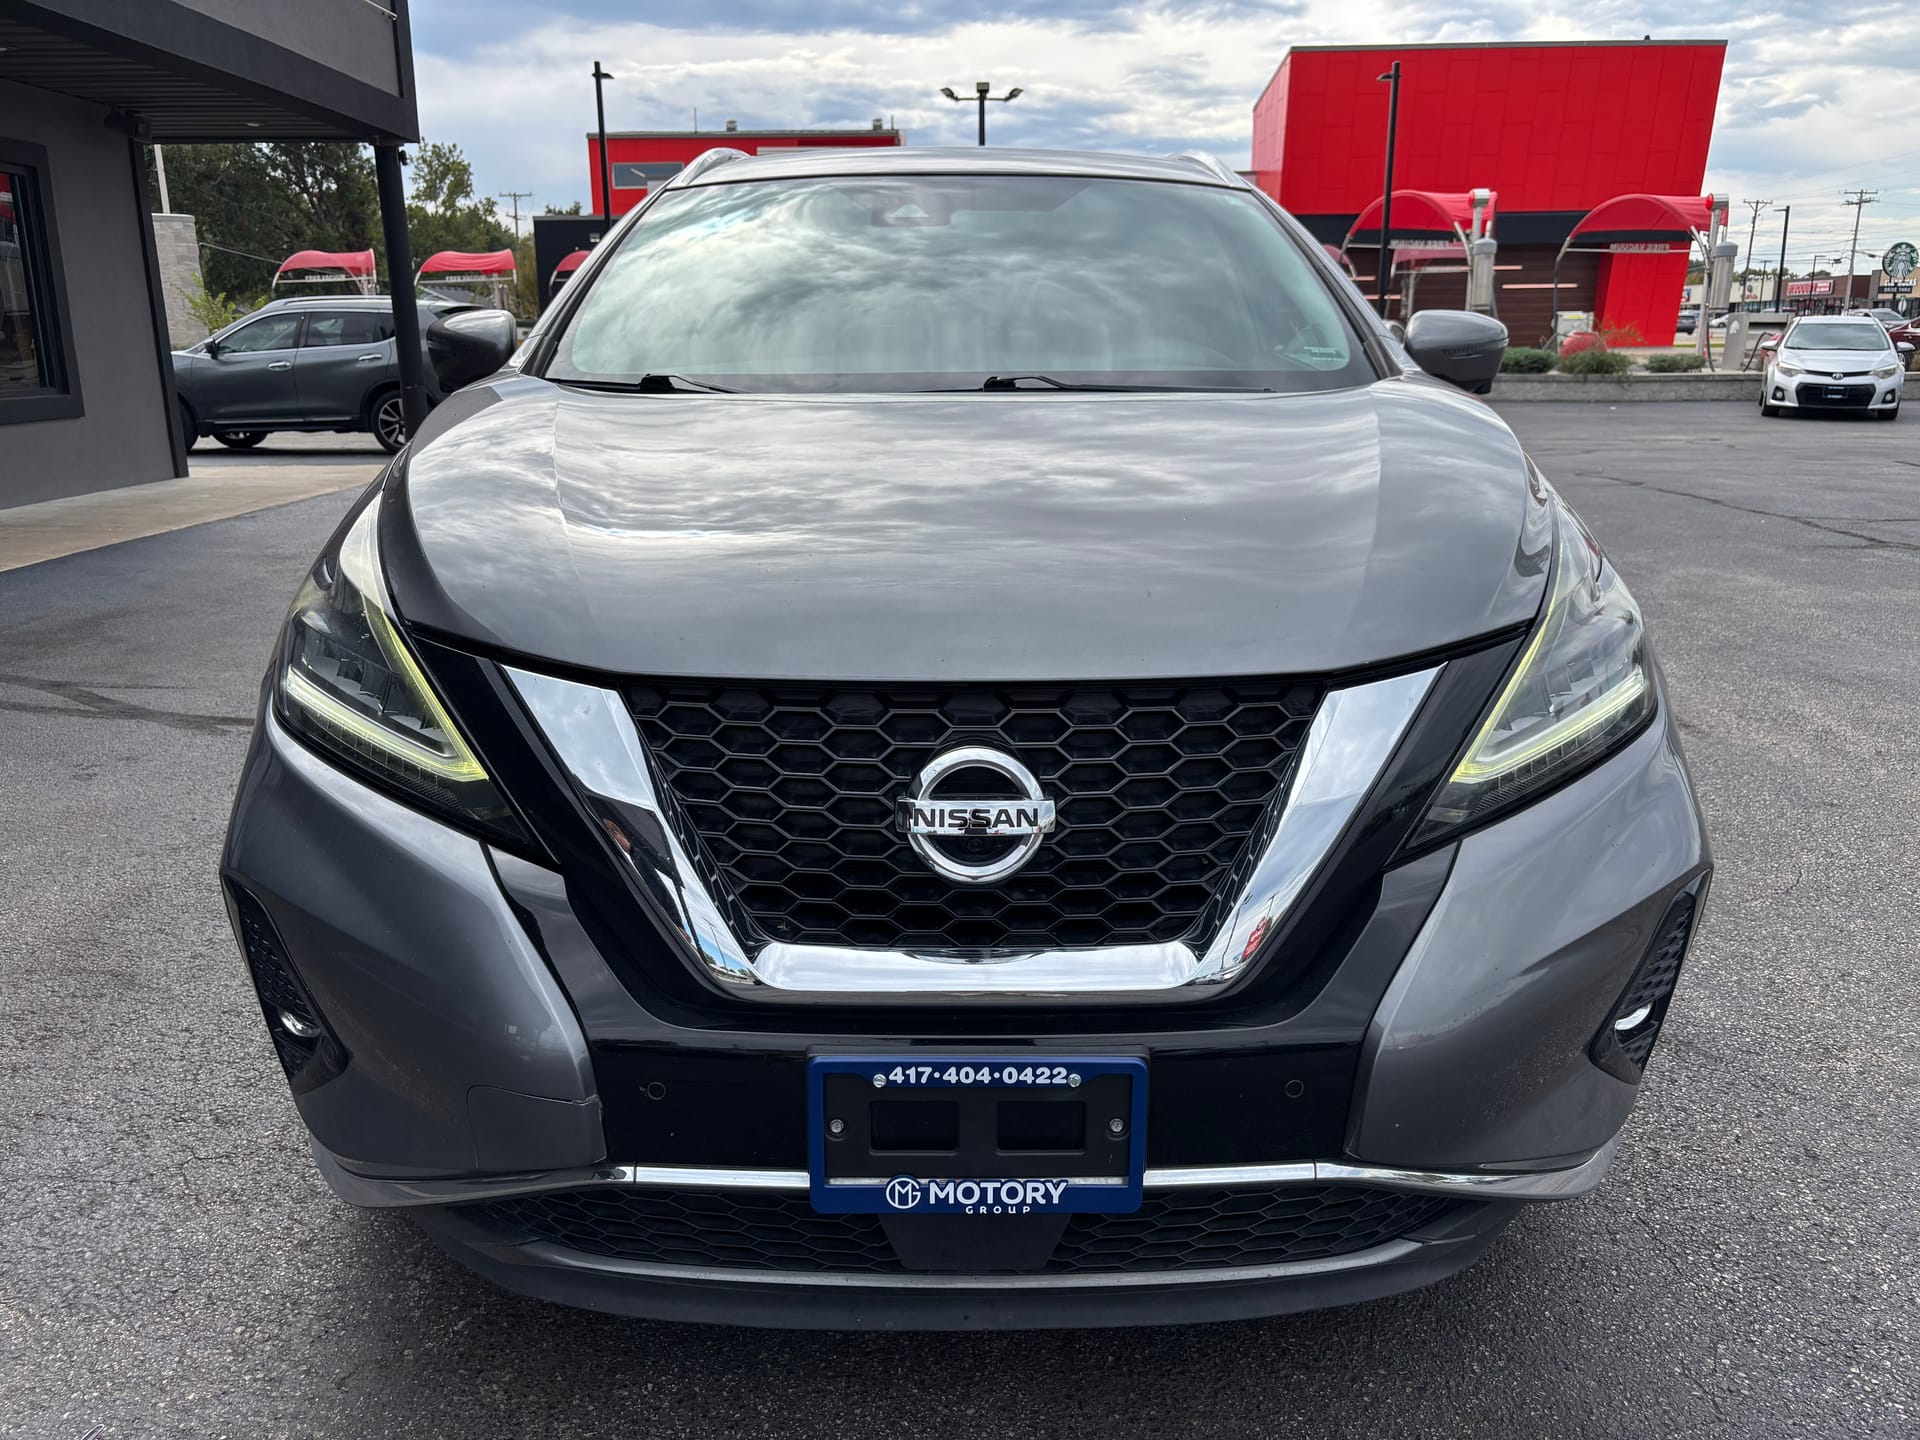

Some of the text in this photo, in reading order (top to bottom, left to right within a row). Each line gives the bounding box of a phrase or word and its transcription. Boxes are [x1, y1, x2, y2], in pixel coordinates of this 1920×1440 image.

[913, 807, 1039, 828] NISSAN
[929, 1182, 1067, 1205] MOTORY
[965, 1205, 1031, 1214] GROUP
